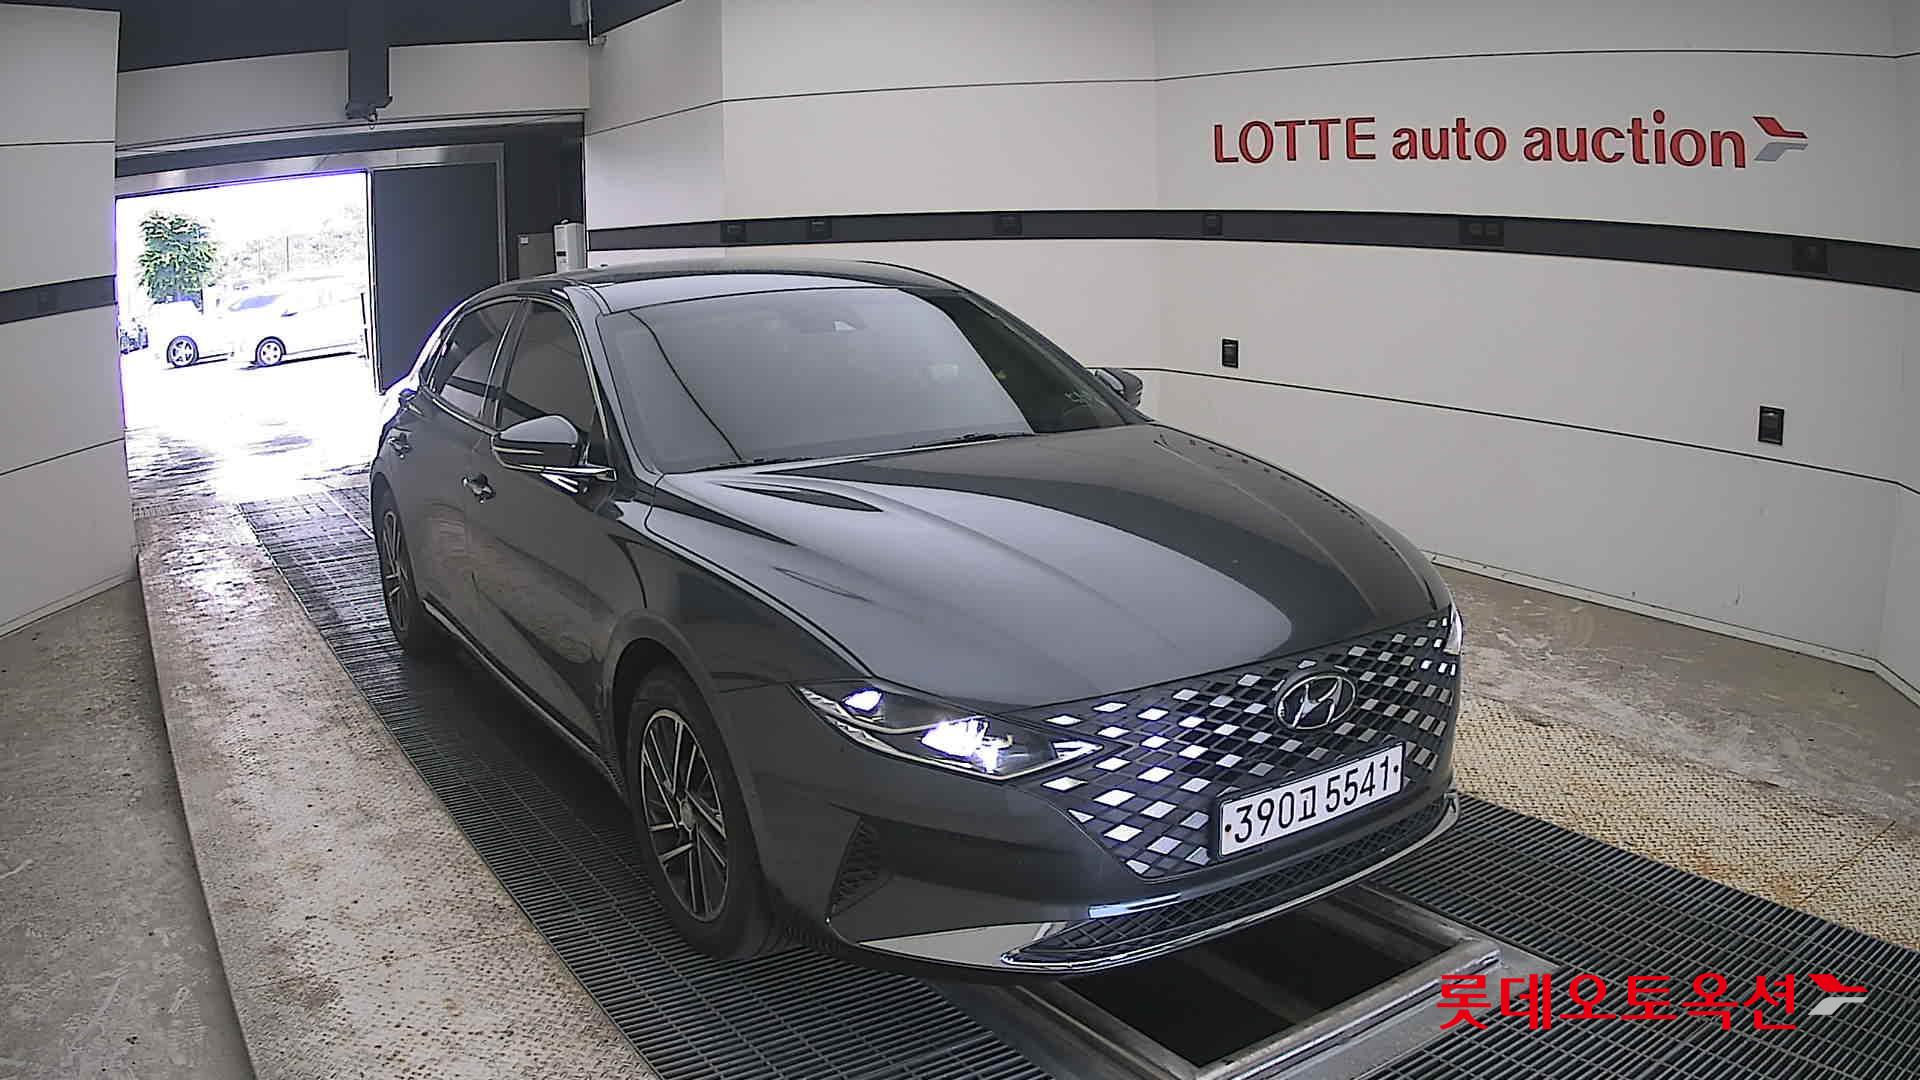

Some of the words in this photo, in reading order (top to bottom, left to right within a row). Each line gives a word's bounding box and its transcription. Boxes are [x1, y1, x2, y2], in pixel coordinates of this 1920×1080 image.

[1213, 116, 1376, 164] LOTTE
[1391, 117, 1508, 162] auto
[1523, 109, 1747, 169] auction
[1233, 785, 1317, 844] 390고
[1325, 755, 1390, 813] 5541
